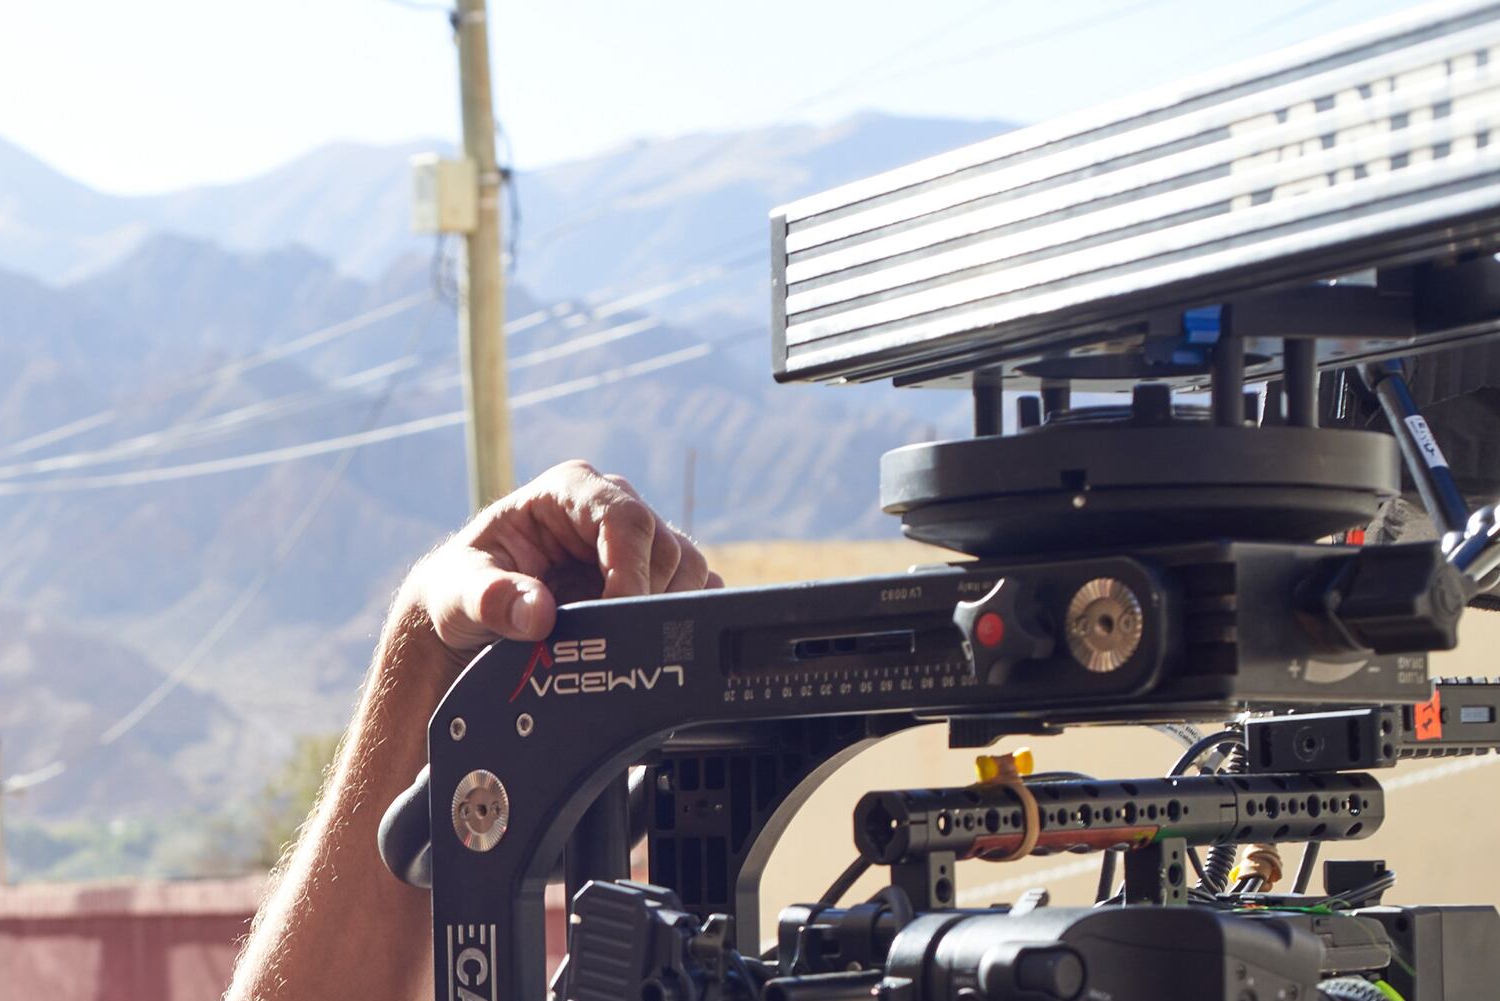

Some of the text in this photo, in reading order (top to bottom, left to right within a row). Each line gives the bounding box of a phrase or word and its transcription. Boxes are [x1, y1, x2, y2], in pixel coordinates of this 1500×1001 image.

[529, 665, 685, 698] LAMBDA
[859, 681, 873, 694] 50
[900, 678, 914, 691] 70
[743, 688, 755, 701] 10
[764, 687, 772, 700] 0
[781, 686, 793, 699] 10
[800, 685, 813, 698] 20
[820, 684, 833, 697] 30
[839, 682, 853, 695] 40
[723, 689, 736, 702] 20
